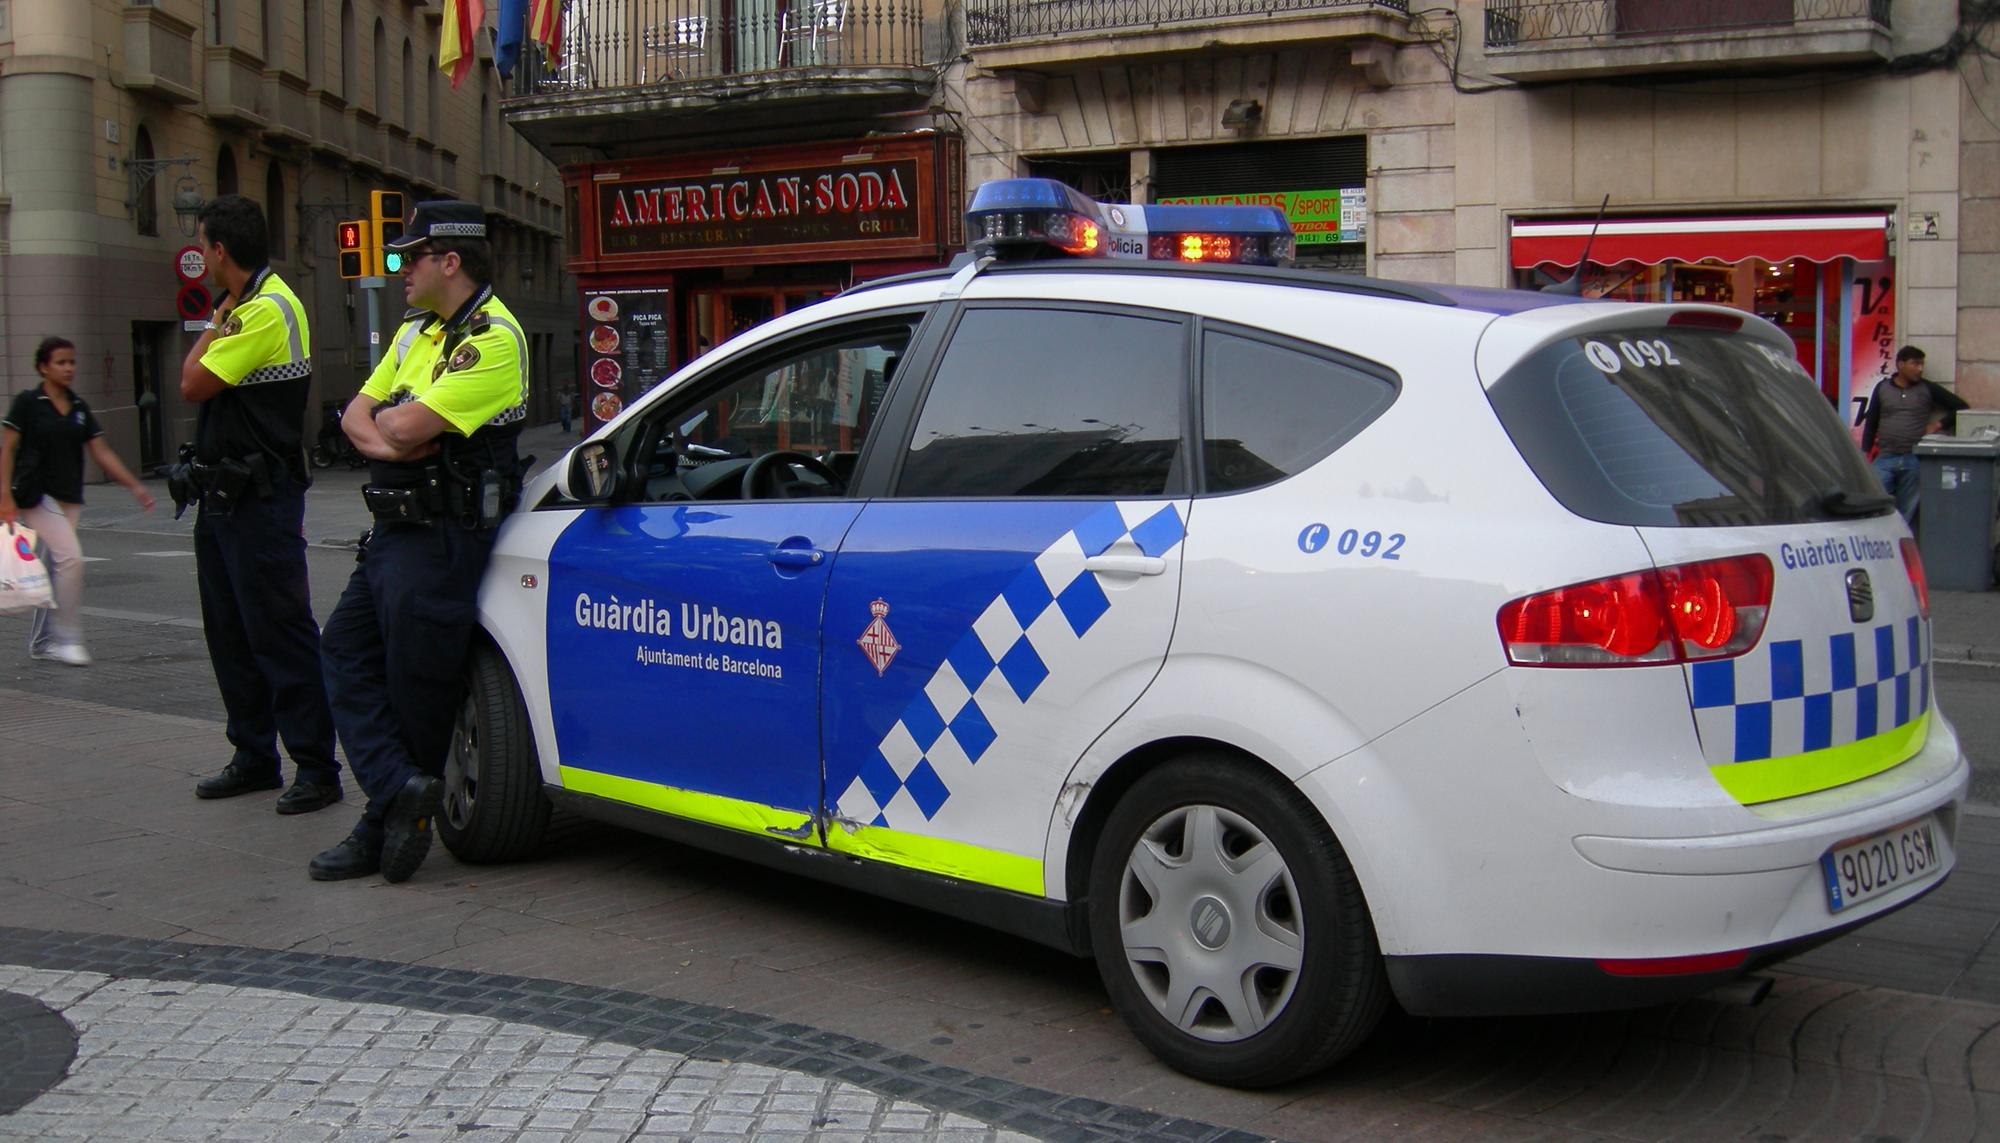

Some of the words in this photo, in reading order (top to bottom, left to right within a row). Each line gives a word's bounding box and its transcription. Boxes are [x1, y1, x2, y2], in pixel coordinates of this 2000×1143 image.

[1326, 233, 1339, 242] 69
[1619, 340, 1680, 368] 092
[1337, 528, 1406, 561] 092
[1781, 538, 1849, 570] Guàrdia
[1850, 536, 1895, 562] Urbana
[575, 593, 671, 637] Guàrdia
[681, 602, 782, 650] Urbana
[636, 645, 703, 670] Ajuntament
[706, 653, 719, 672] de
[722, 653, 782, 679] Barcelona
[1842, 840, 1899, 897] 9020
[1901, 824, 1937, 874] GSW
